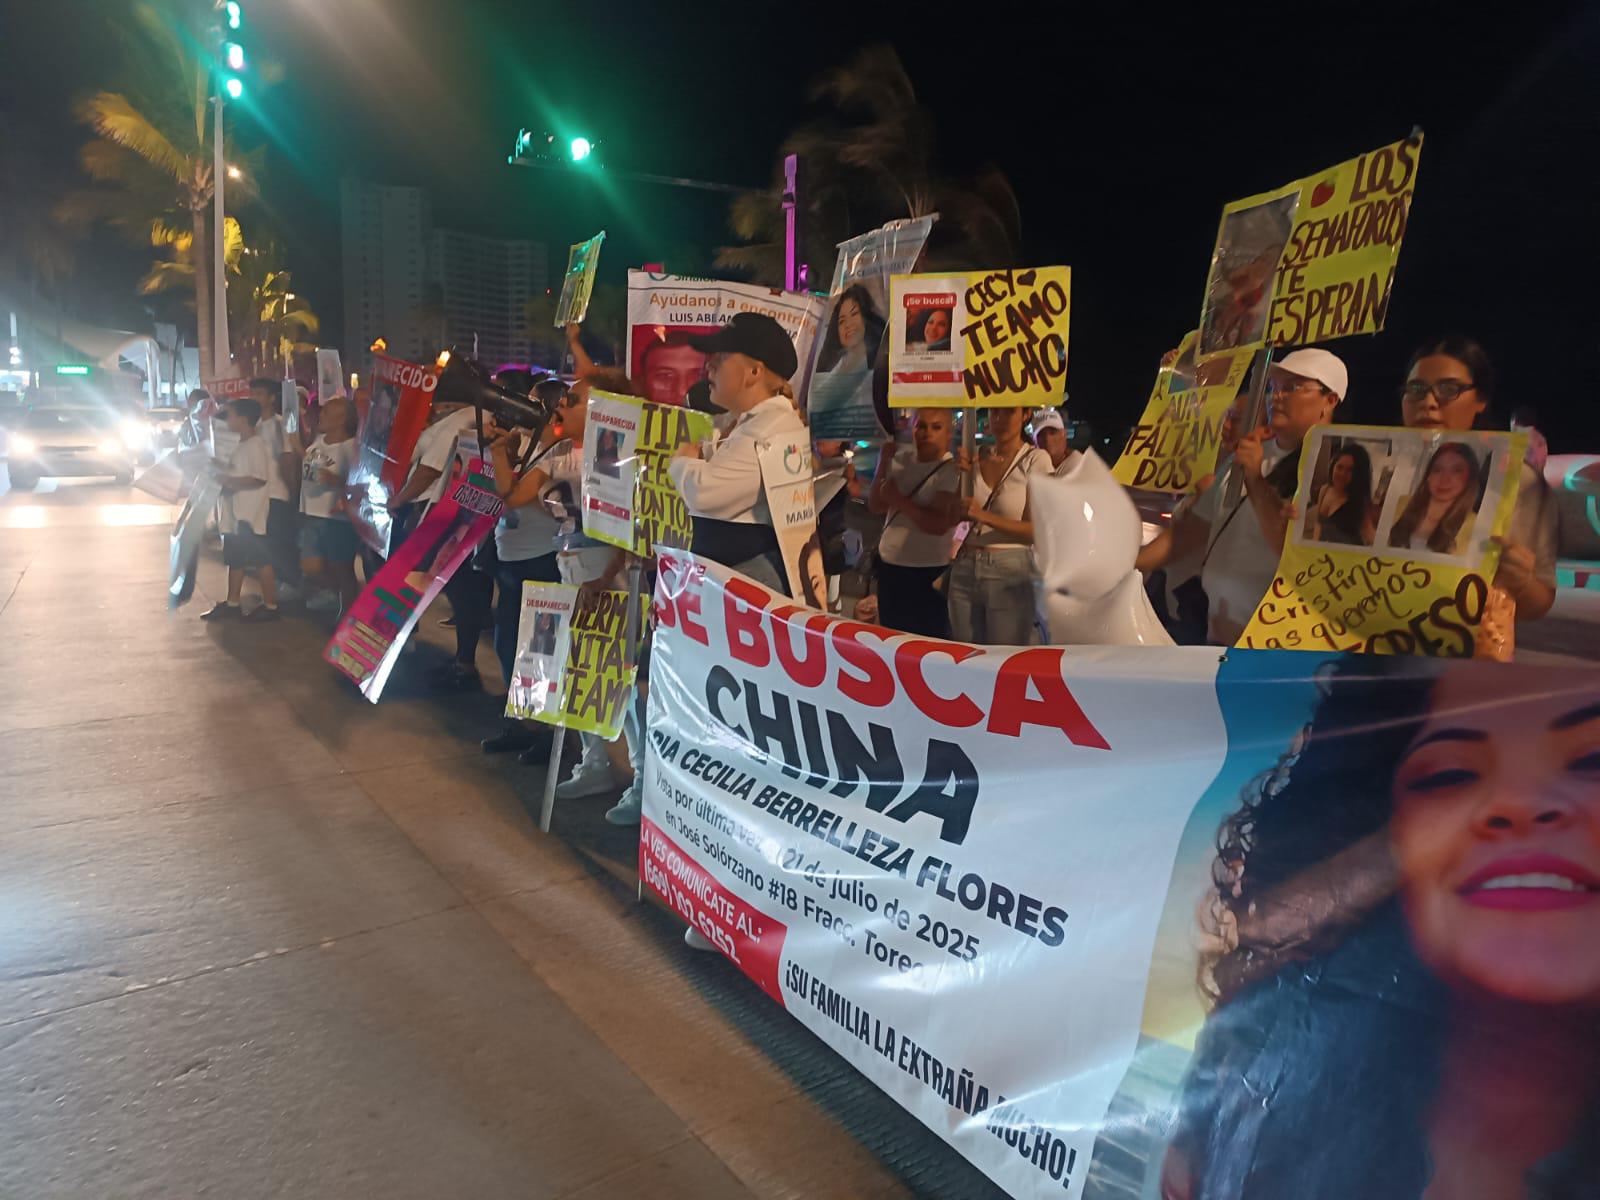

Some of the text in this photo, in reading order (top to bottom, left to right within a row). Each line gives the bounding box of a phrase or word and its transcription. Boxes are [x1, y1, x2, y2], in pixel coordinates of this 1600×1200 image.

[1349, 137, 1420, 203] LOS
[727, 299, 735, 308] a
[964, 269, 1016, 316] CECY
[1276, 263, 1308, 296] TE
[669, 312, 693, 323] LUIS
[962, 333, 1067, 399] MUCHO
[642, 402, 691, 450] TIA
[1125, 416, 1223, 461] FALTAN
[1132, 458, 1192, 489] DOS
[1258, 556, 1394, 625] Cristina
[1272, 554, 1335, 599] Cecy
[723, 577, 1112, 750] BUSCA
[705, 665, 979, 845] CHINA
[640, 823, 650, 849] LA
[651, 838, 668, 863] VES
[667, 850, 735, 926] COMUNÍCATE
[656, 770, 673, 798] Vista
[675, 789, 693, 811] por
[695, 797, 735, 836] última
[804, 860, 827, 888] de
[829, 869, 878, 912] julio
[883, 897, 910, 931] de
[916, 913, 980, 963] 2025
[665, 809, 677, 829] en
[678, 815, 700, 847] José
[702, 835, 764, 891] Solórzano
[768, 878, 798, 911] #18
[804, 895, 856, 947] Fracc.
[680, 748, 757, 801] CECILIA
[752, 785, 915, 879] BERRELLEZA
[916, 856, 1069, 947] FLORES
[786, 959, 809, 1000] ¡SU
[810, 976, 870, 1045] FAMILIA
[874, 1019, 896, 1062] LA
[898, 1035, 990, 1118] EXTRAÑA
